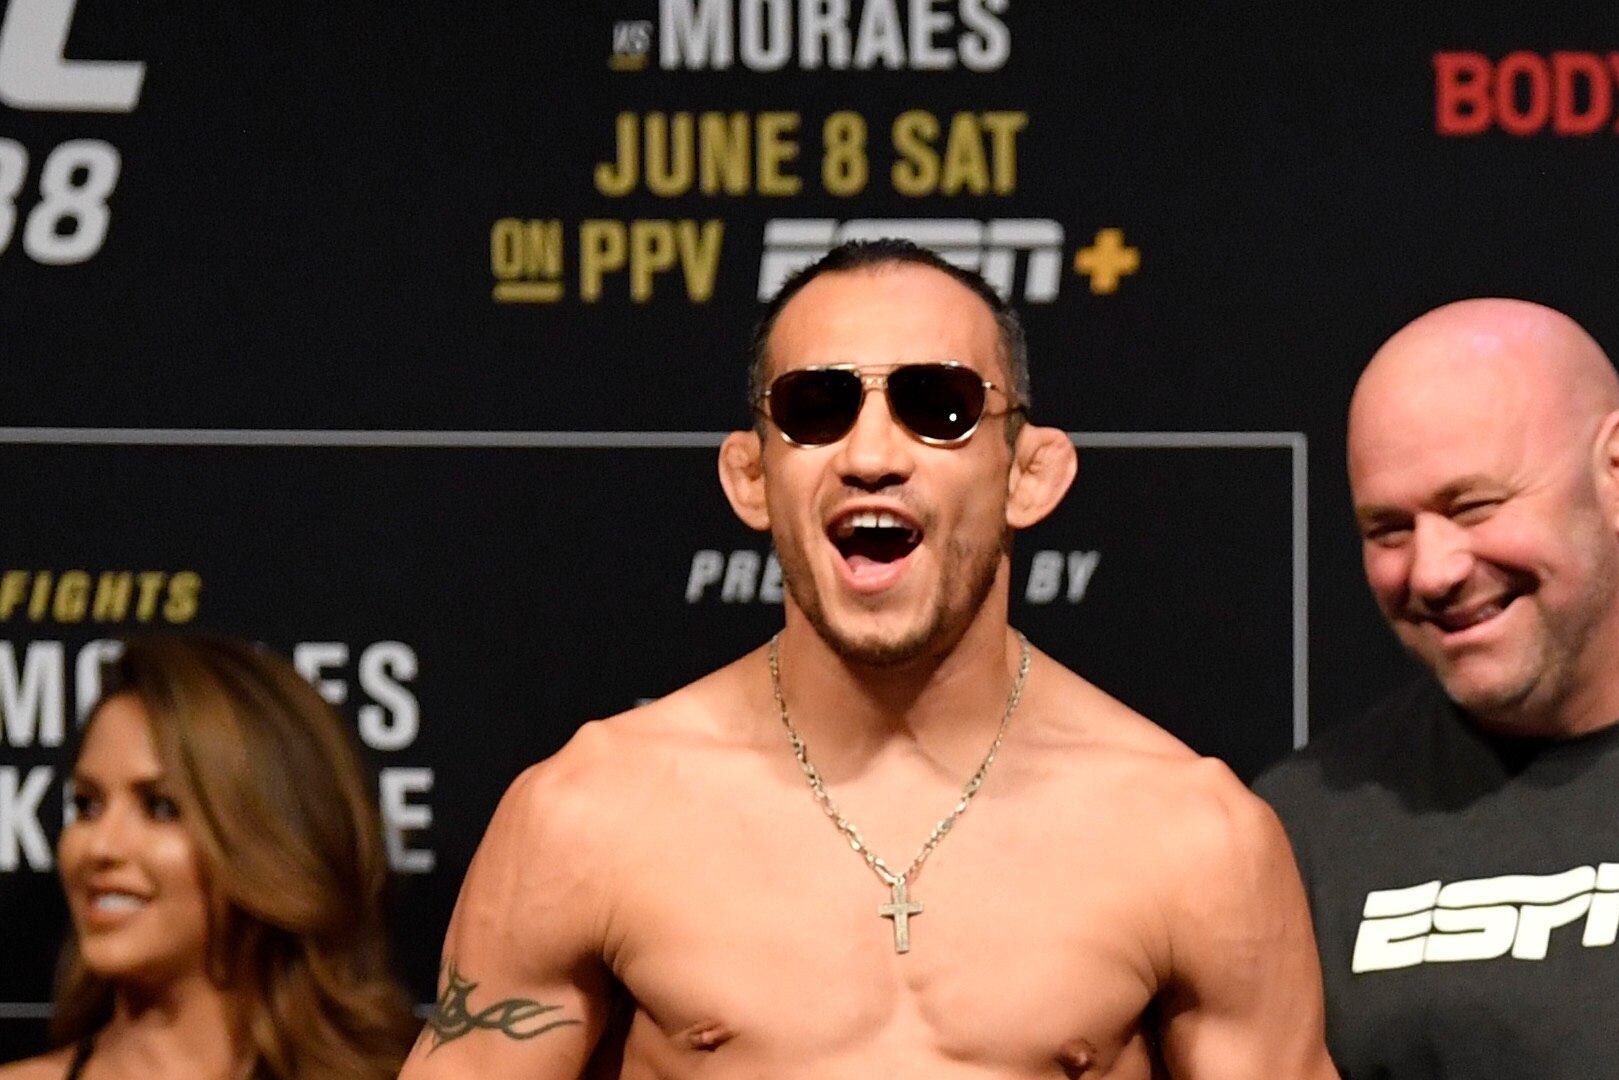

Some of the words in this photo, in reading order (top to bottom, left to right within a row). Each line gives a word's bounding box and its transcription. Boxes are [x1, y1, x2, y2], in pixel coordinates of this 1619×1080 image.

[659, 0, 1011, 71] MORAES
[594, 112, 801, 196] JUNE
[822, 111, 868, 196] 8
[891, 110, 1028, 196] SAT
[490, 218, 564, 281] ON
[579, 219, 723, 301] PPV
[0, 570, 202, 624] FIGHTS
[1025, 550, 1100, 603] BY
